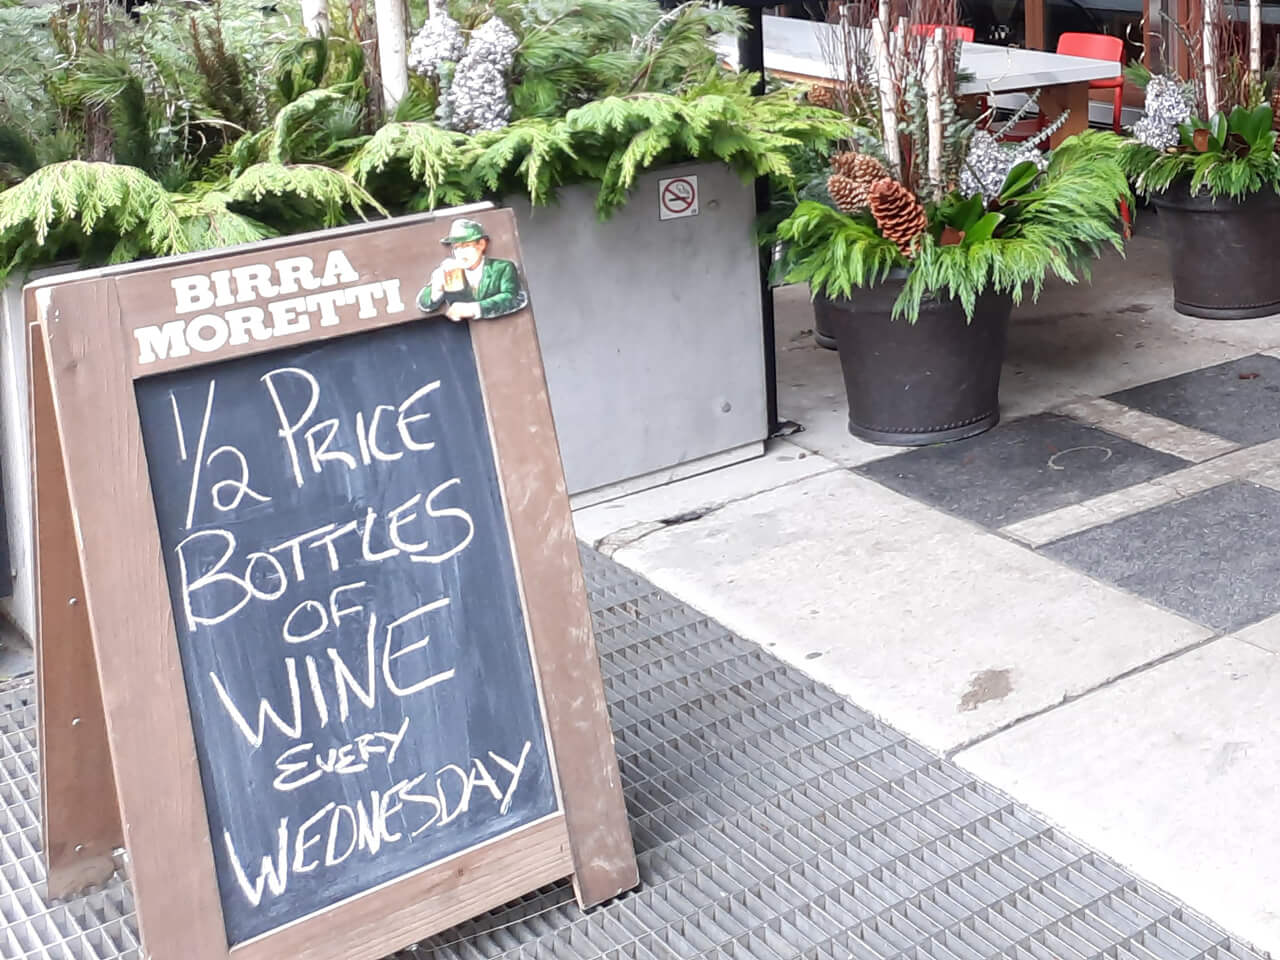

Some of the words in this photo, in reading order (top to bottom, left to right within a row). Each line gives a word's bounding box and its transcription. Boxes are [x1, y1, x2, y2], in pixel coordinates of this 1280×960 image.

[133, 279, 404, 365] MORETTI
[171, 248, 360, 315] BIRRA
[171, 379, 271, 529] 1/2
[261, 367, 442, 488] PRICE
[174, 477, 475, 631] BOTTLES
[283, 581, 366, 643] OF
[210, 598, 456, 747] WINE
[272, 717, 410, 792] EVERY
[224, 740, 531, 907] WEDNESDAY
